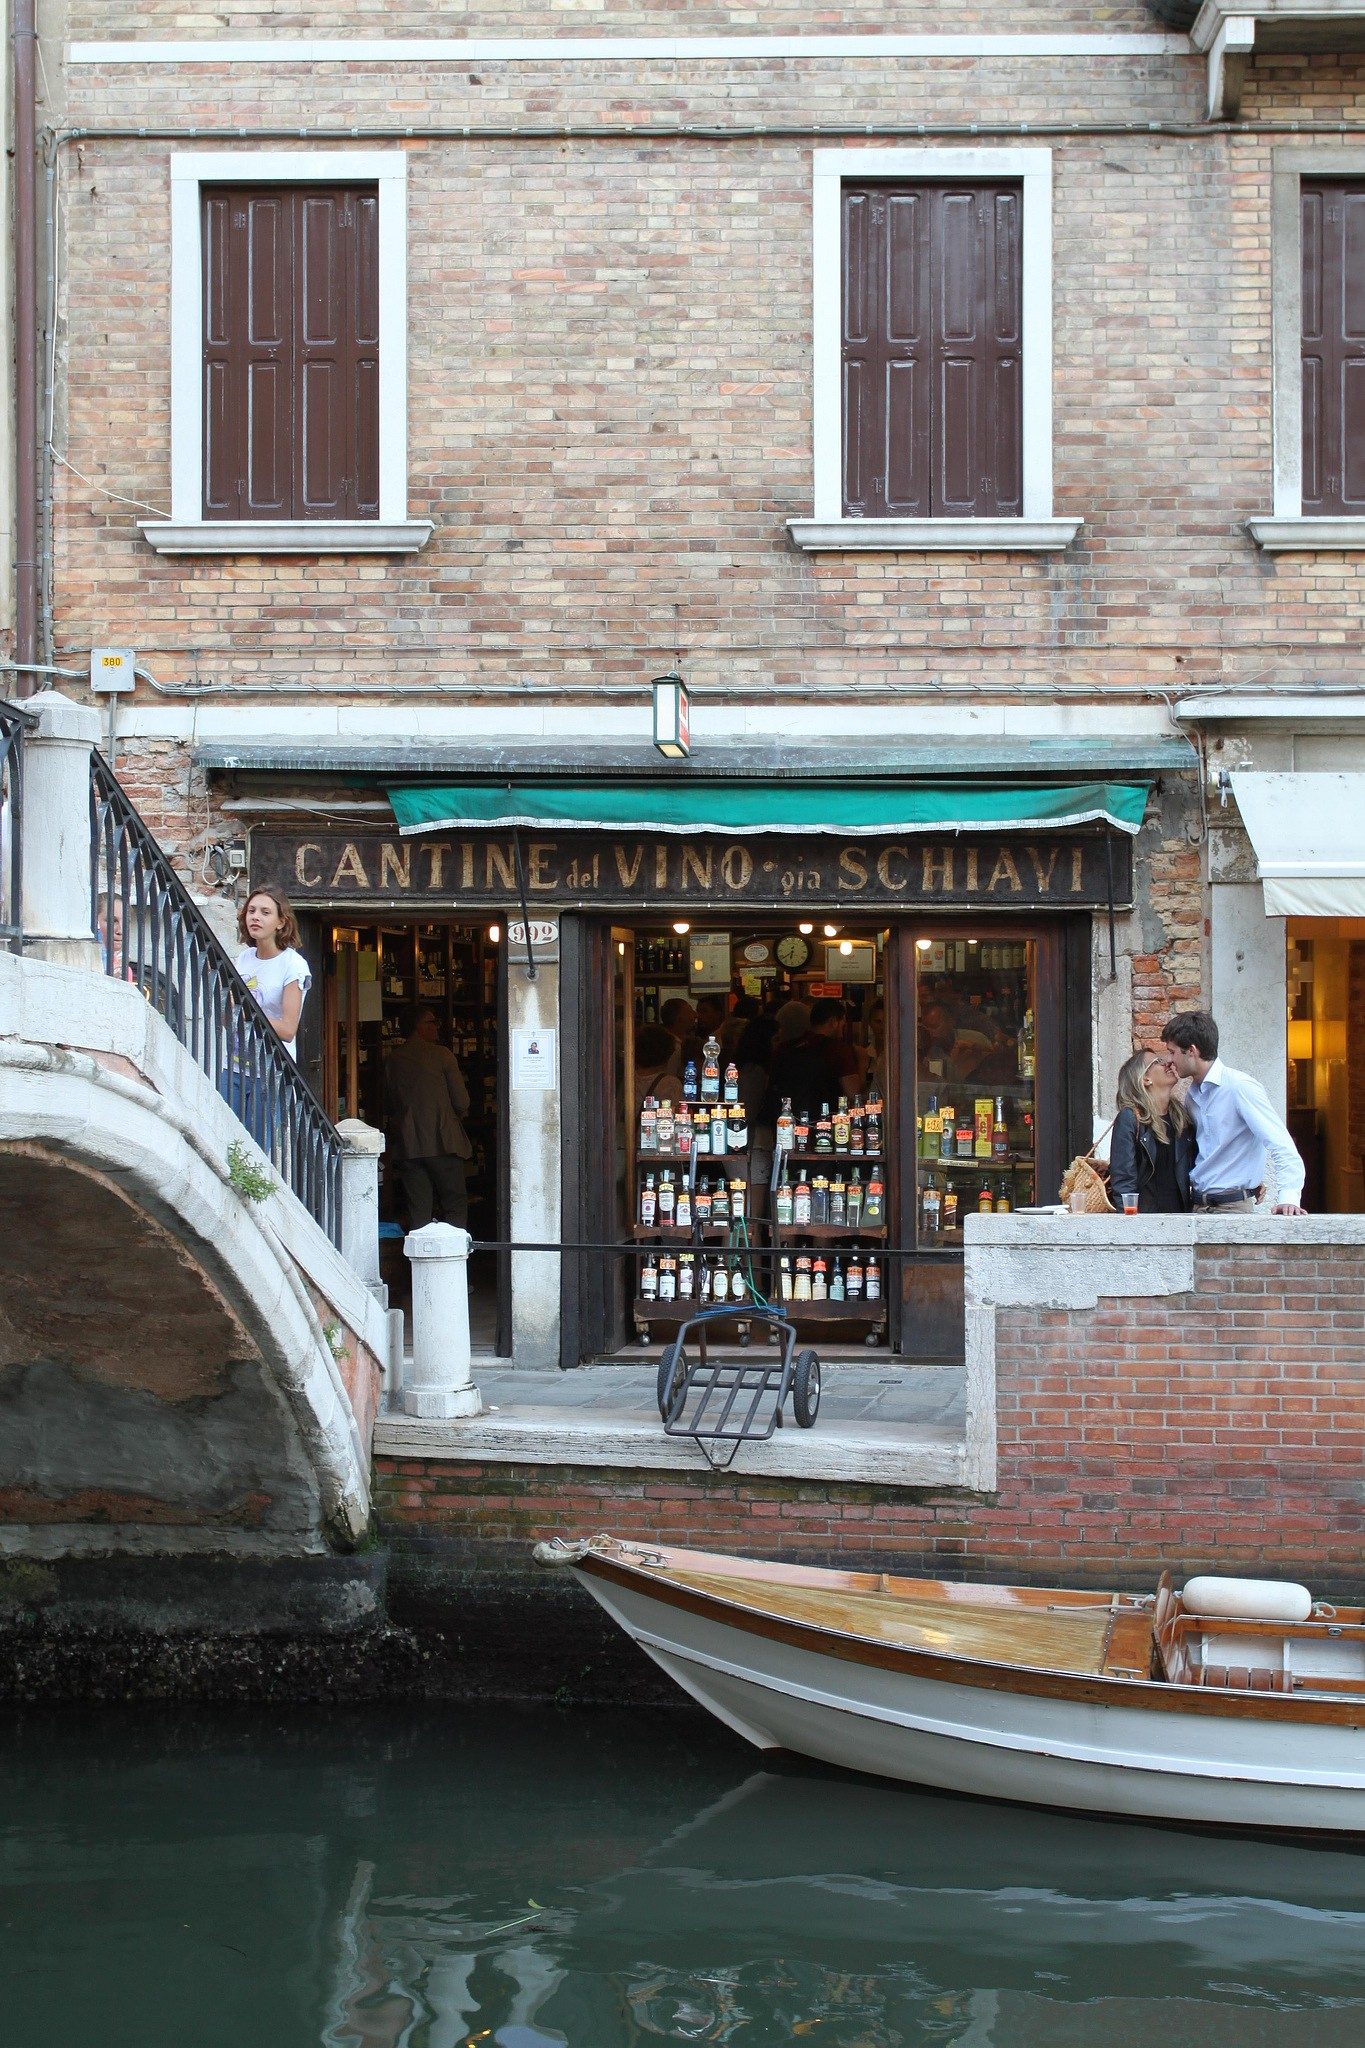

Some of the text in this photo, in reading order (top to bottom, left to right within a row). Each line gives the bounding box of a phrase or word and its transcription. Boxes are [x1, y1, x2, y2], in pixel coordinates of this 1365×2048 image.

[103, 657, 121, 666] 380
[294, 842, 559, 891] CANTINE
[566, 853, 600, 890] del
[613, 843, 755, 891] VINO
[837, 845, 1086, 893] SCHIAVI
